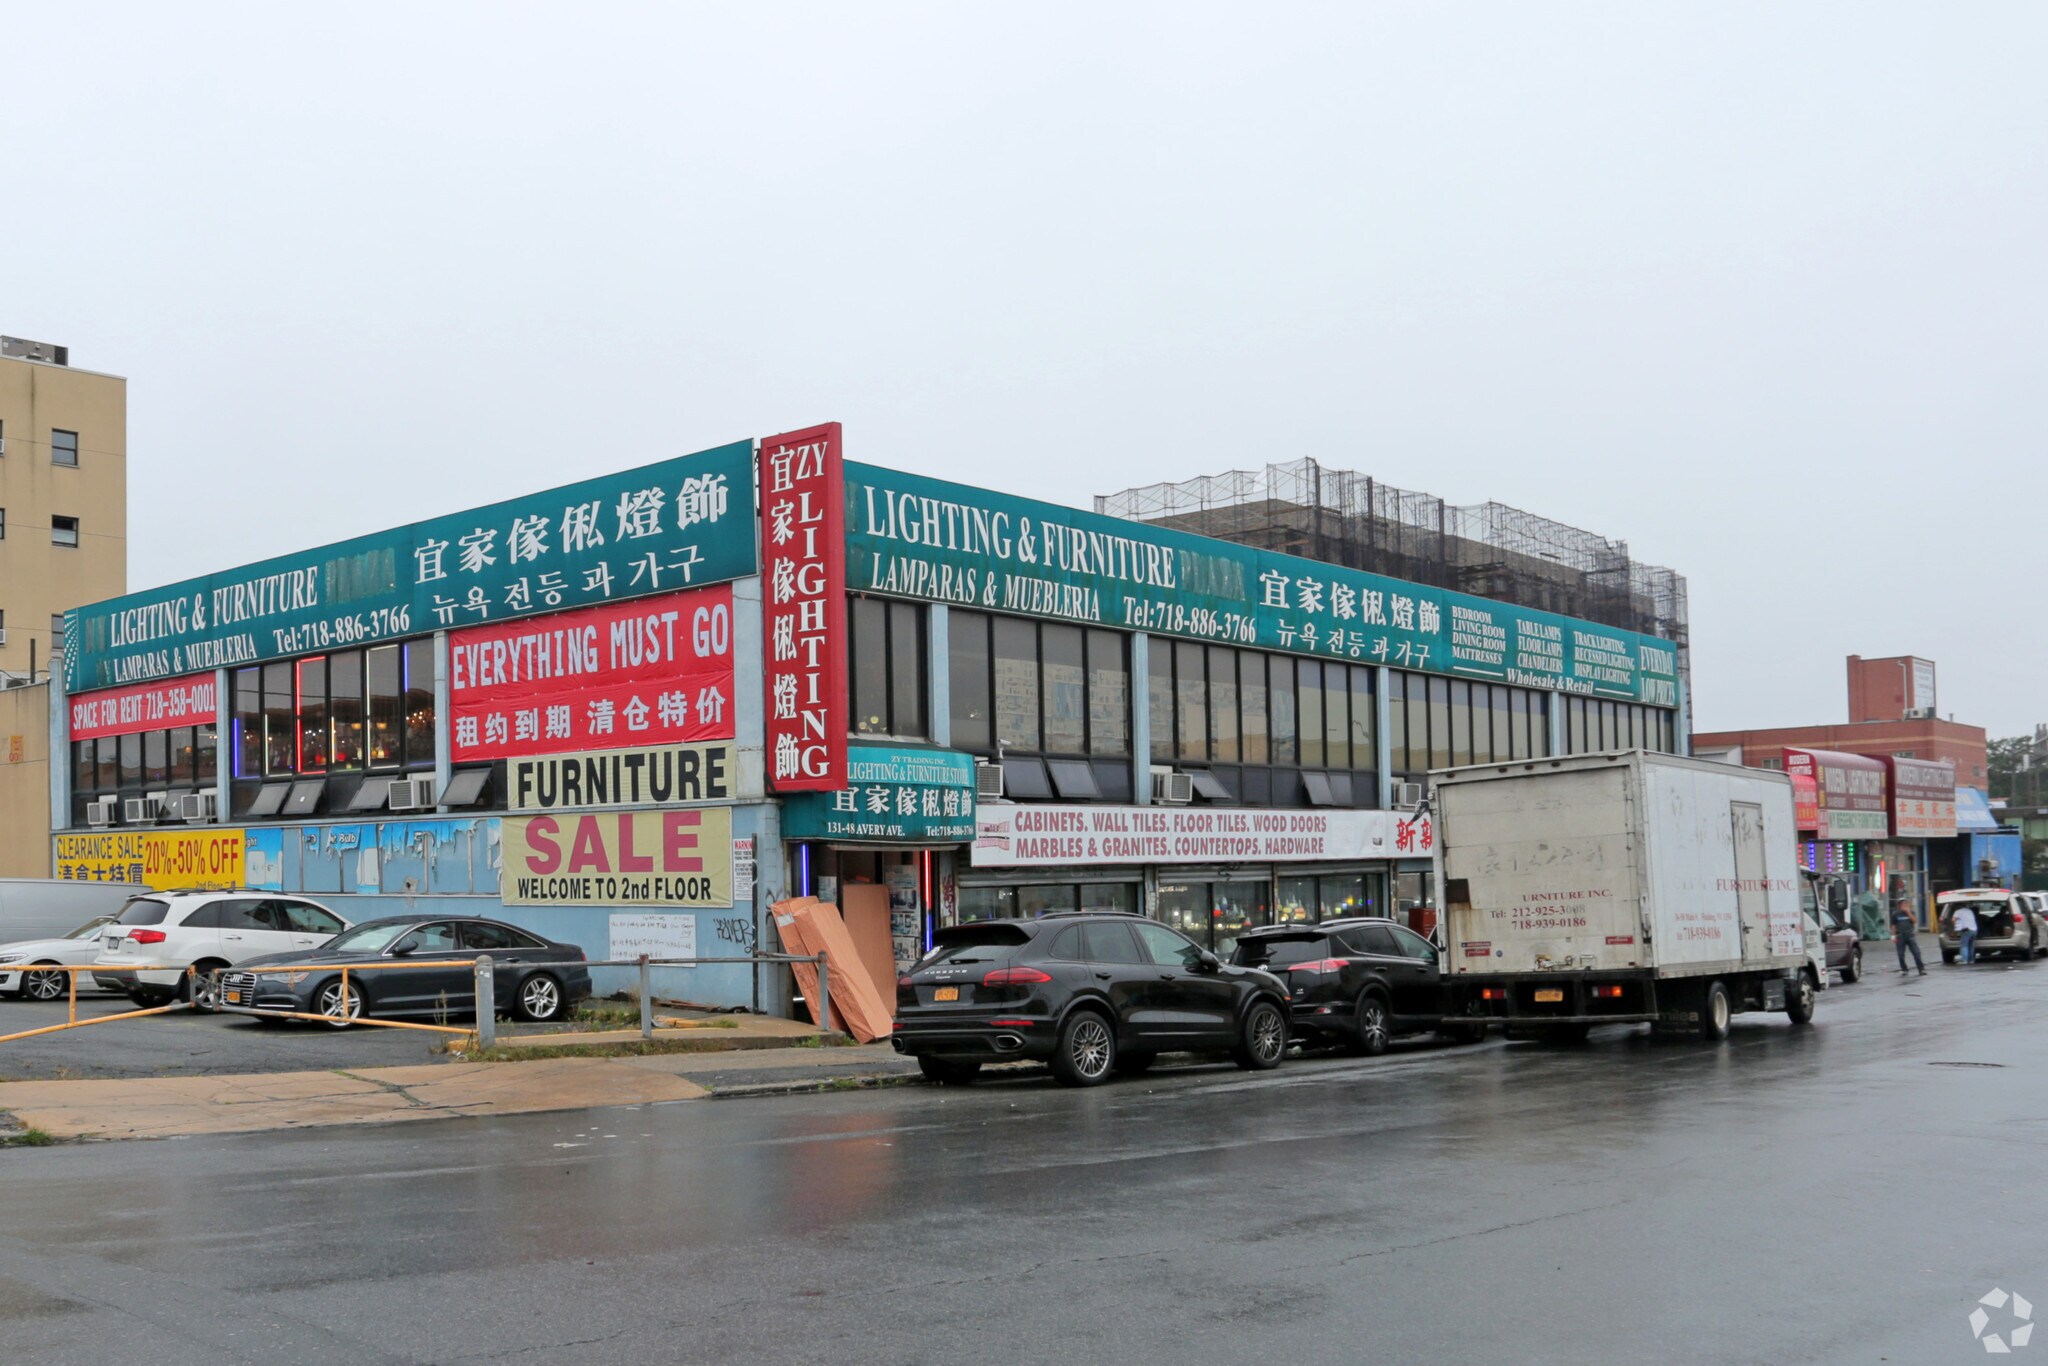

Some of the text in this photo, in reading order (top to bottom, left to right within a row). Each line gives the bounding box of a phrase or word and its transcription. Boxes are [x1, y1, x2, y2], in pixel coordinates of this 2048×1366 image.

[864, 486, 1176, 589] LIGHTING & FURNITURE
[871, 553, 1100, 622] LAMPARAS & MUEBLERIA
[110, 566, 318, 648] LIGHTING & FURNITURE
[796, 442, 830, 777] ZY LIGHTING
[1452, 605, 1492, 624] BEDROOM
[1453, 618, 1505, 639] LIVING ROOM
[1516, 618, 1562, 641] TABLE LAMPS
[454, 604, 729, 690] EVERYTHING MUST GO
[1452, 631, 1506, 652] DINING ROOM
[1518, 635, 1563, 658] FLOOR LAMPS
[1597, 636, 1625, 654] LIGHTING
[114, 633, 257, 683] LAMPARAS & MUEBLERIA
[1452, 645, 1502, 665] MATTRESSES
[1518, 652, 1563, 673] CHANDELIERS
[1608, 653, 1635, 671] LIGHTING
[1507, 667, 1593, 694] Wholesale & Retail
[1602, 667, 1631, 685] LIGHTING
[73, 684, 215, 730] SPACE FOR RENT 718-358-0001
[456, 686, 726, 748] 租约到期 清仓特价
[903, 756, 933, 764] TRADING
[518, 747, 727, 808] FURNITURE
[847, 762, 898, 781] LIGHTING
[900, 770, 905, 779] &
[907, 766, 949, 783] FURNITURE
[828, 822, 905, 836] 131-48 AVERY AVE.
[1015, 811, 1088, 832] CABINETS.
[1093, 812, 1128, 832] WALL
[1132, 813, 1170, 833] TILES.
[1174, 814, 1212, 833] FLOOR
[1217, 815, 1250, 832] TILES.
[1253, 815, 1287, 832] WOOD
[1290, 815, 1327, 833] DOORS
[57, 836, 143, 859] CLEARANCE SALE
[525, 811, 703, 875] SALE
[1016, 837, 1324, 858] MARBLES & GRANITES. COUNTERTOPS. HARDWARE
[145, 838, 239, 875] 20%-50% OFF
[518, 877, 711, 900] WELCOME TO 2nd FLOOR
[1523, 889, 1613, 903] URNITURE INC.
[1490, 910, 1507, 919] Tel:
[1511, 917, 1586, 930] 718-939-0186
